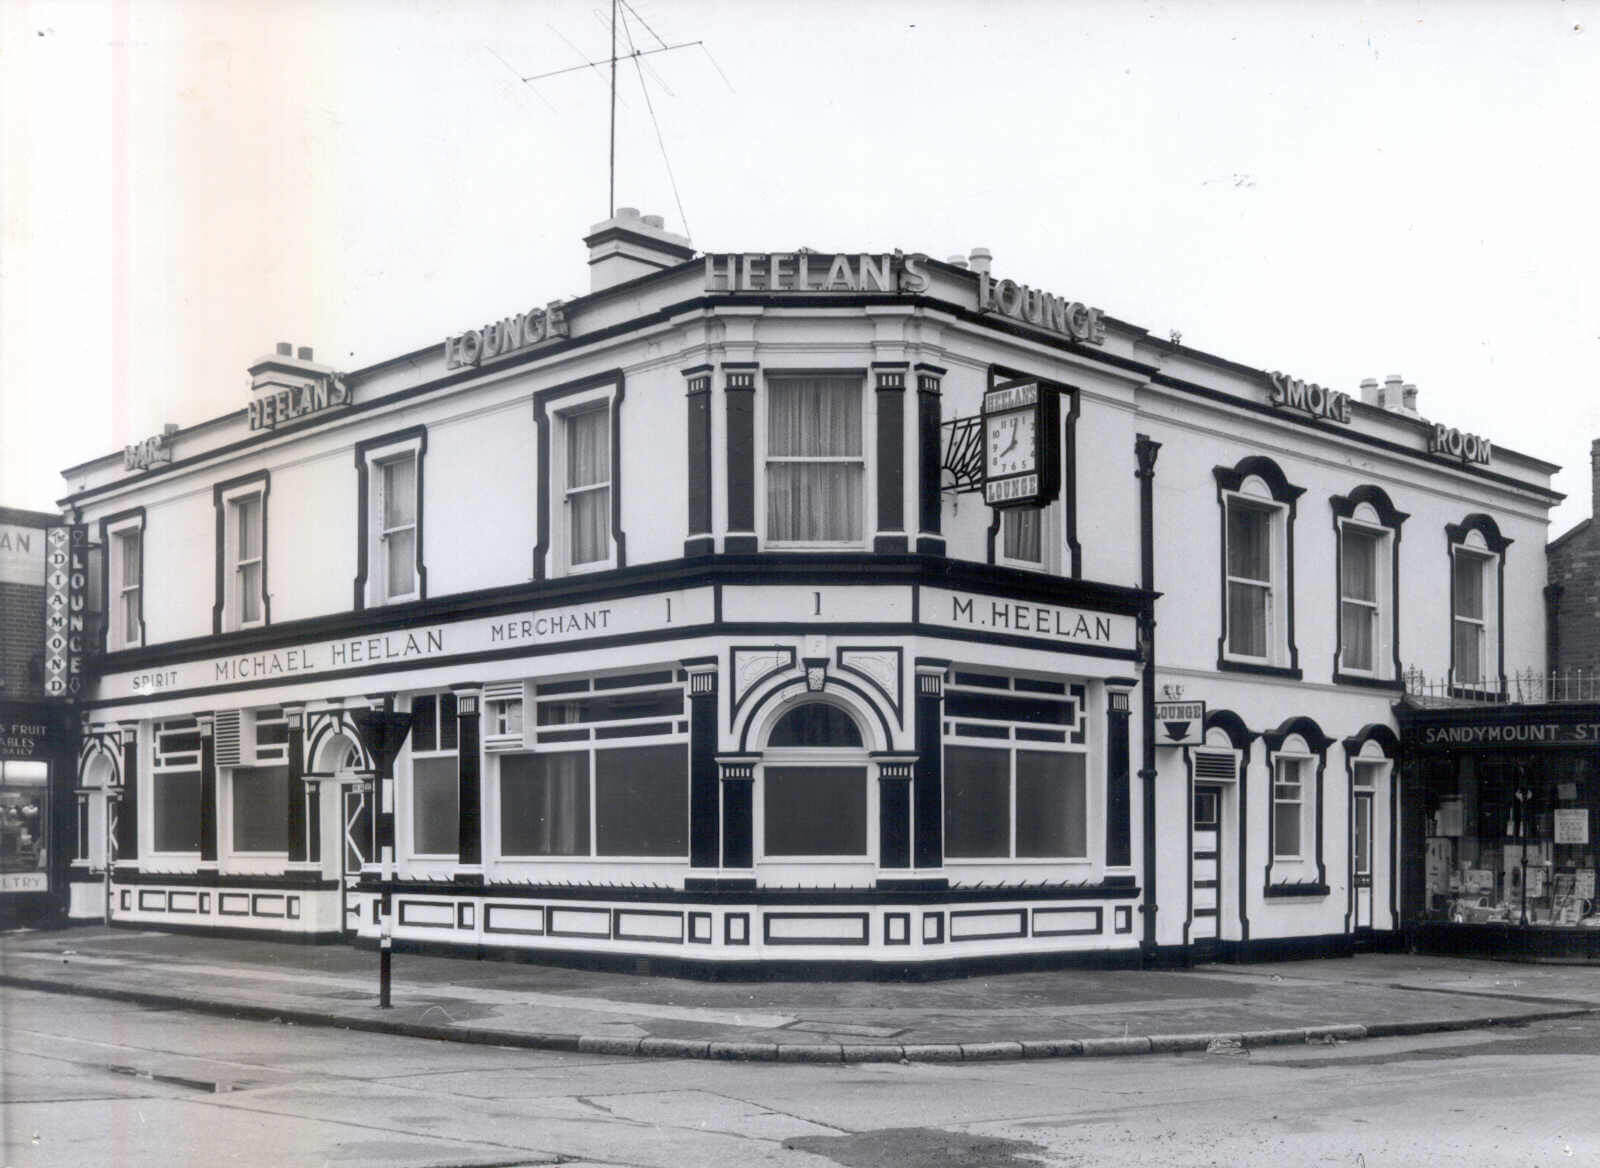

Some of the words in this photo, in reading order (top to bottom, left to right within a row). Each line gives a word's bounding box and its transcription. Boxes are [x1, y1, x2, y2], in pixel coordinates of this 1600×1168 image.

[704, 248, 930, 294] HEELAN'S
[446, 299, 569, 370] LOUNGE
[980, 271, 1105, 346] LOUNGE
[249, 373, 349, 431] HEELAN'S
[1270, 370, 1351, 424] SMOKE
[1435, 423, 1491, 465] ROOM
[988, 475, 1037, 501] LOUNGE
[51, 553, 66, 691] DIAMOND
[69, 552, 85, 674] LOUNGE
[132, 671, 178, 690] SPIRIT
[215, 649, 315, 681] MICHAEL
[331, 629, 444, 666] HEELAN
[491, 609, 611, 642] MERCHANT
[11, 723, 47, 737] FRUIT
[1154, 705, 1201, 720] LOUNGE
[1426, 724, 1560, 742] SANDYMOUNT
